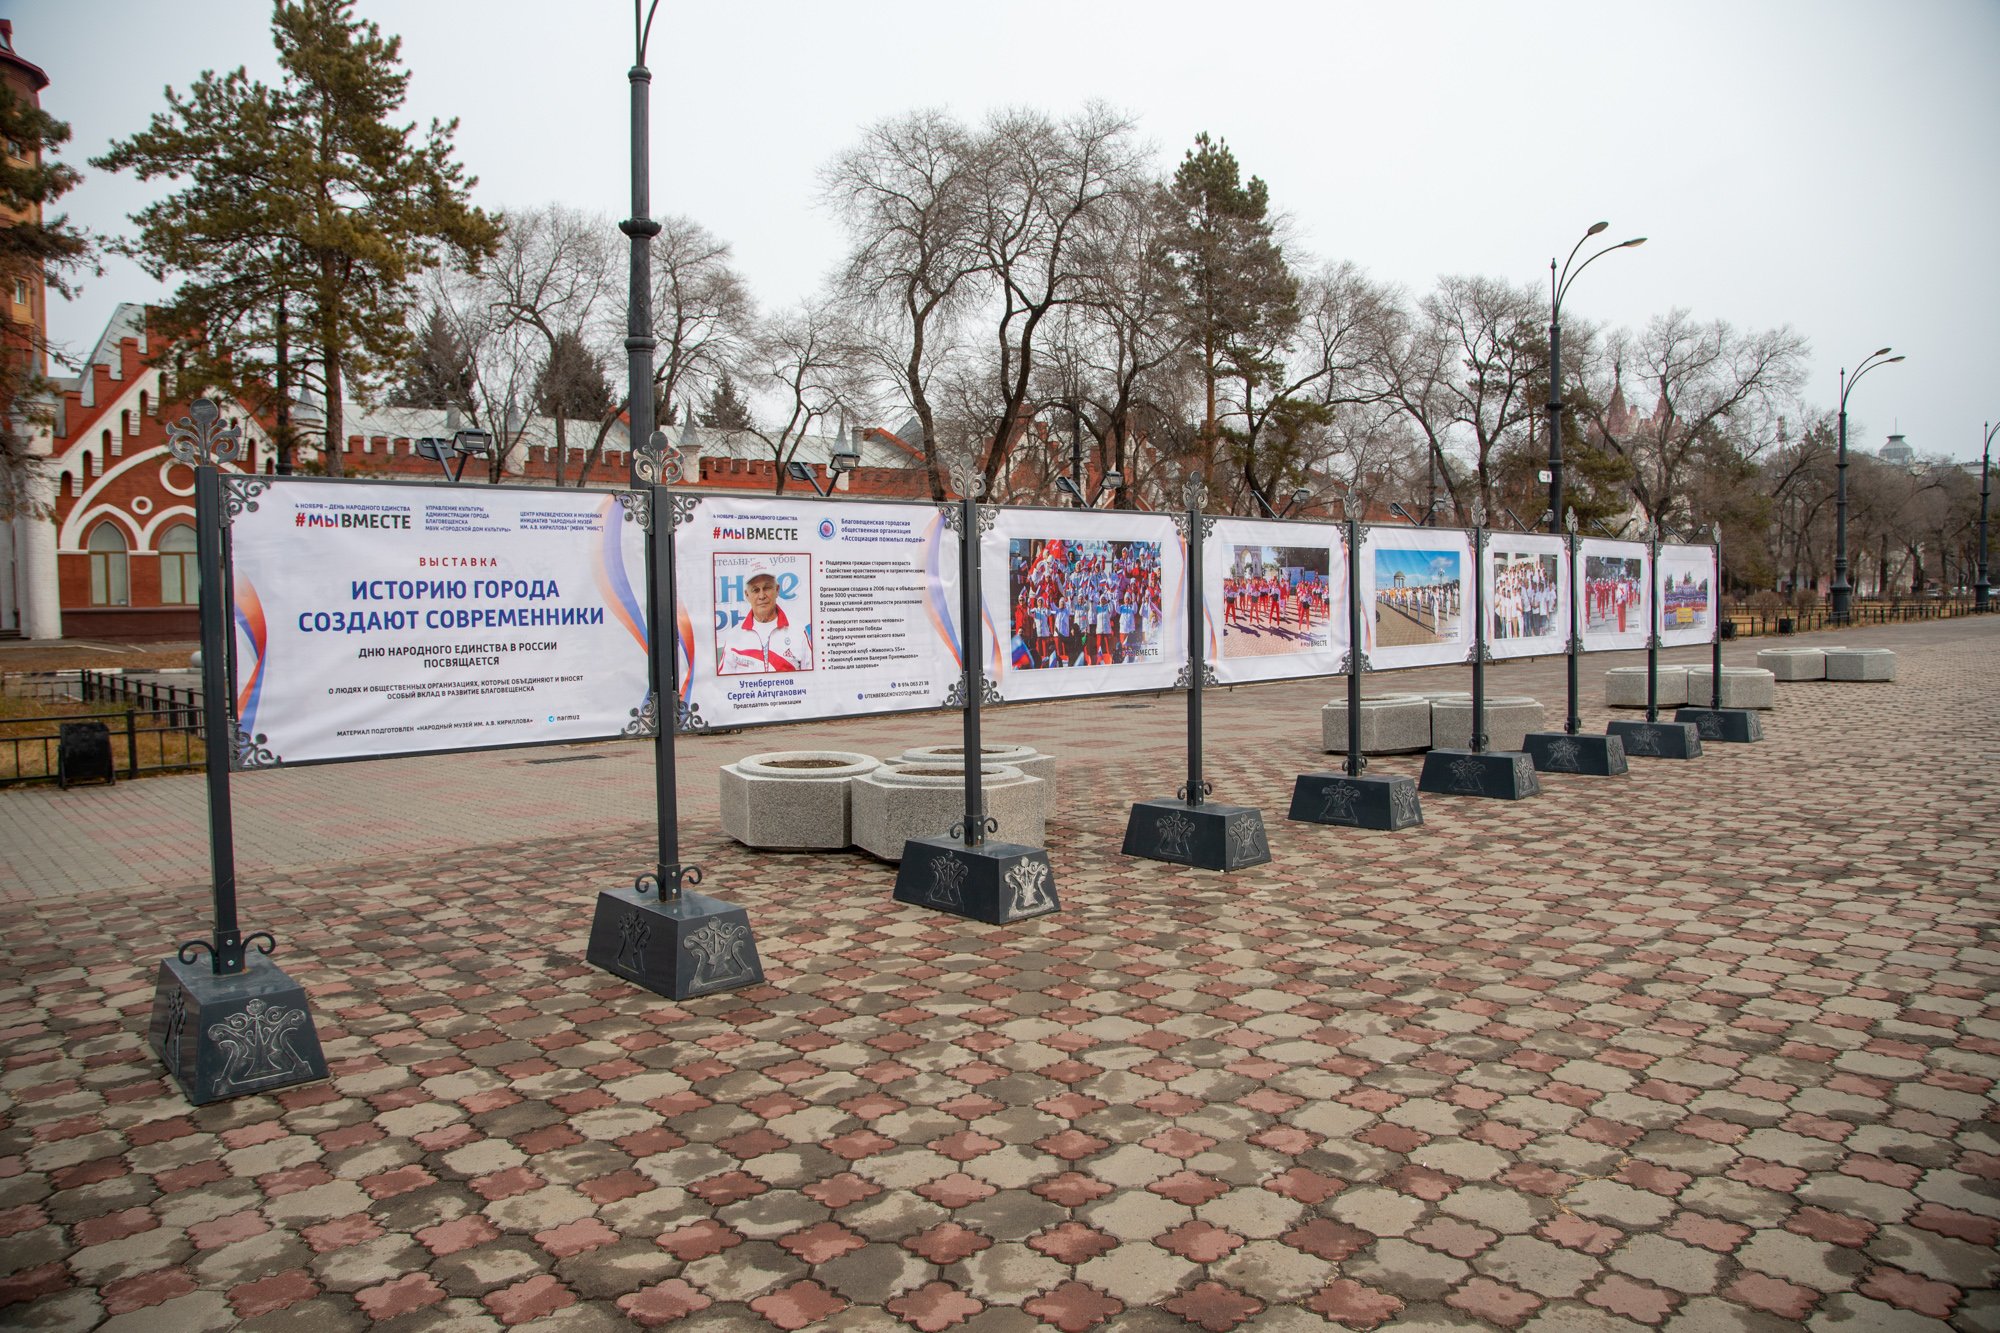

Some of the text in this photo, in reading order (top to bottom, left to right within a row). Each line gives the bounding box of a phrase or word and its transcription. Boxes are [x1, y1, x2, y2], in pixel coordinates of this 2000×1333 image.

[296, 512, 411, 529] #МЫВМЕСТЕ
[713, 527, 798, 541] #МЫВМЕСТЕ
[420, 557, 498, 567] ВЫСТАВКА
[352, 580, 560, 601] ИСТОРИЮ ГОРОДА
[299, 607, 604, 634] СОЗДАЮТ СОВРЕМЕННИКИ
[358, 642, 558, 659] ДНЮ НАРОДНОГО ЕДИНСТВА В РОССИИ
[424, 656, 500, 668] ПОСВЯЩАЕТСЯ
[335, 686, 362, 694] ЛЮДЯХ
[370, 683, 426, 692] ОБЩЕСТВЕННЫХ
[427, 681, 479, 690] ОРГАНИЗАЦИЯХ,
[481, 679, 510, 687] КОТОРЫЕ
[512, 677, 554, 685] ОБЪЕДИНЯЮТ
[739, 679, 794, 689] Утенбергенов
[387, 692, 416, 700] ОСОБЫЙ
[481, 686, 535, 694] БЛАГОВЕЩЕНСКА
[727, 689, 807, 701] Сергей Айтуганович
[733, 702, 769, 710] Председатель
[337, 728, 370, 737] МАТЕРИАЛ
[371, 726, 414, 735] ПОДГОТОВЛЕН
[417, 723, 452, 731] «НАРОДНЫЙ
[454, 720, 473, 728] МУЗЕЙ
